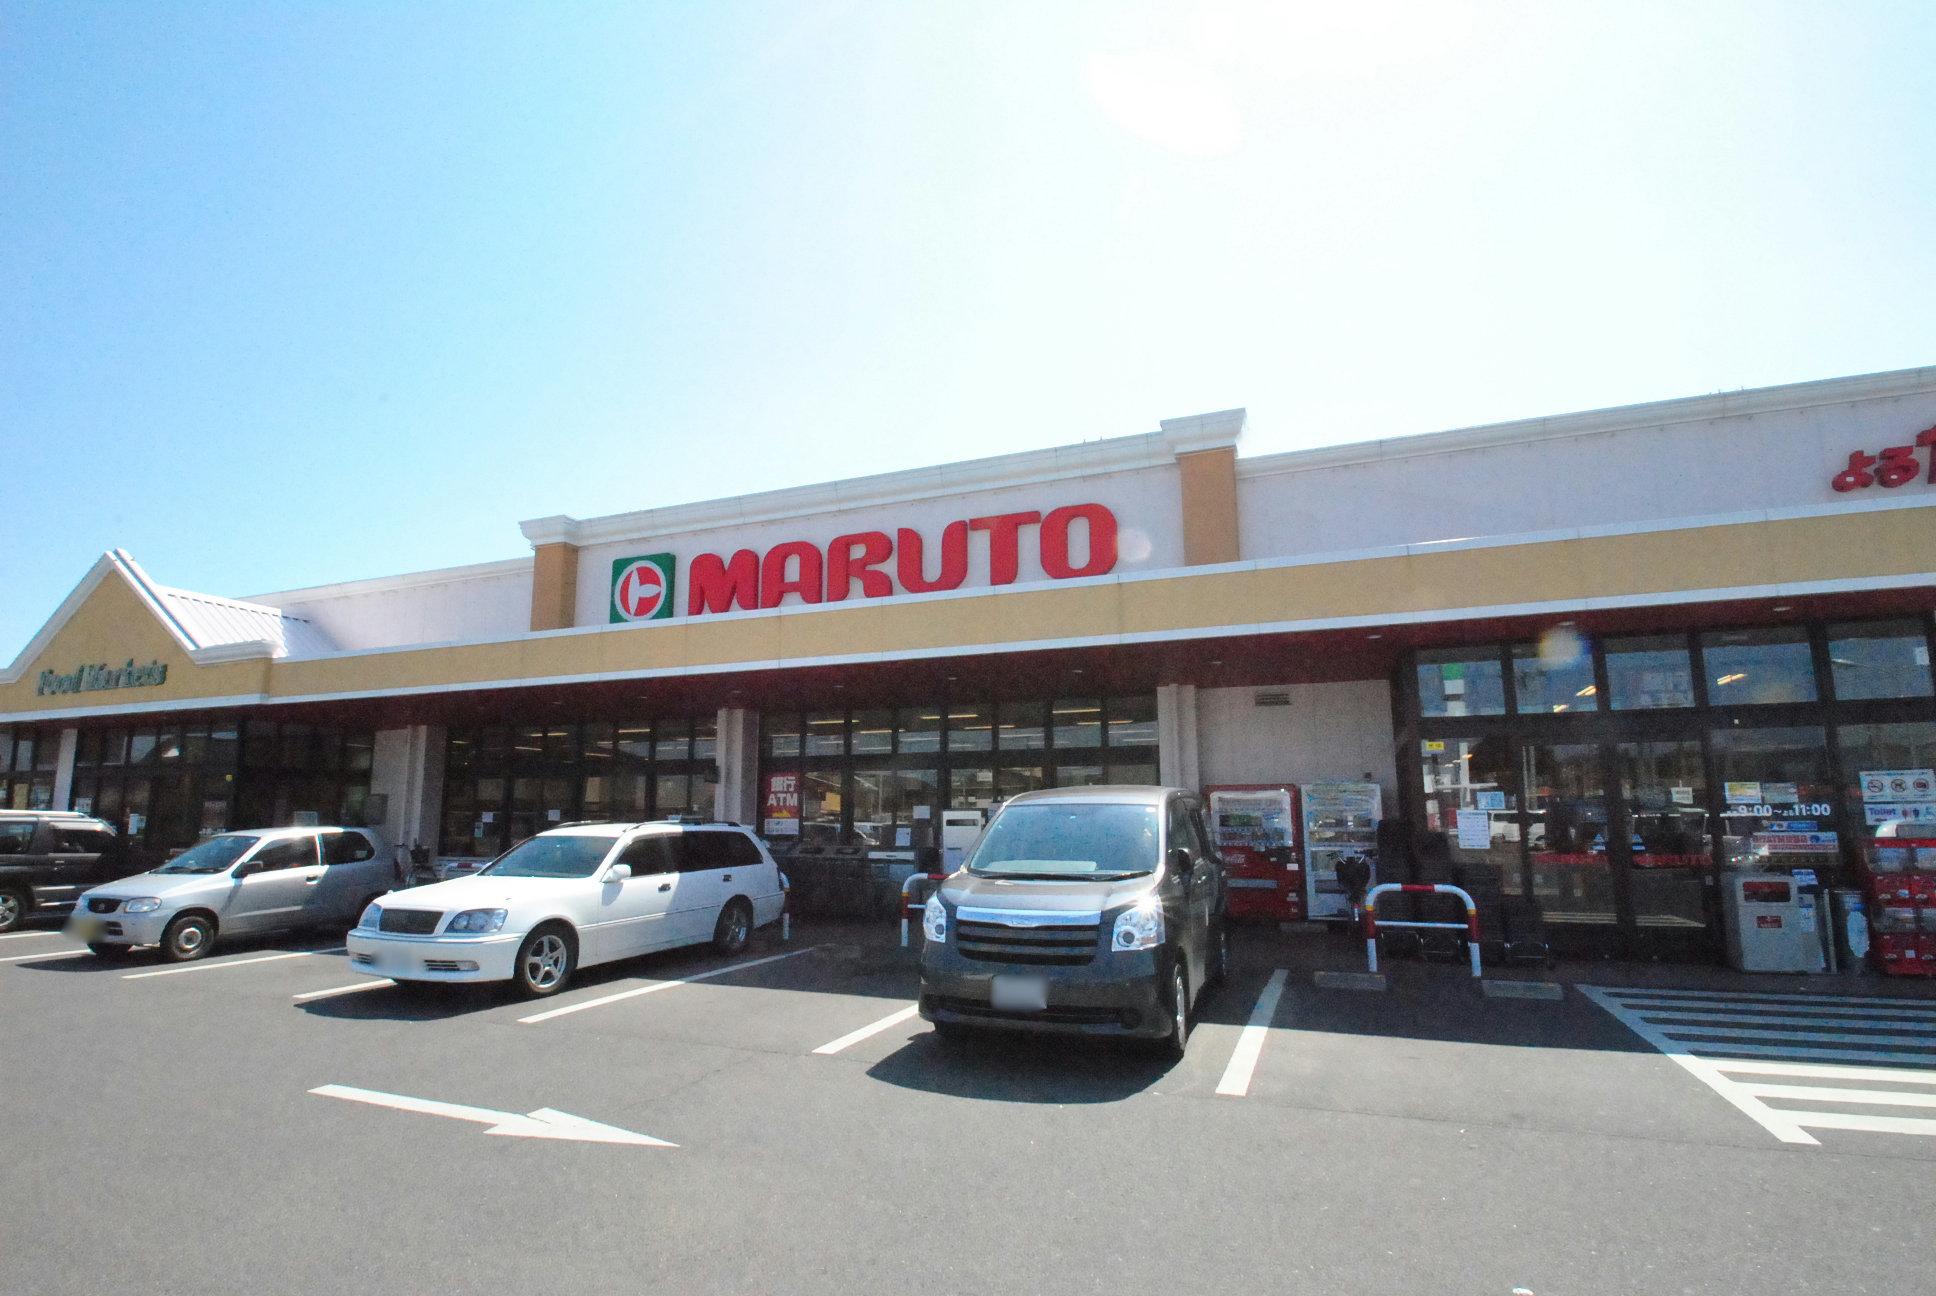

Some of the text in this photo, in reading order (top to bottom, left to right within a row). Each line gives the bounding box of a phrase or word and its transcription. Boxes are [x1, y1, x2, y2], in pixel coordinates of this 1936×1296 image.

[688, 503, 1118, 615] MARUTO
[37, 664, 86, 696] Food
[770, 776, 796, 791] 銀行
[767, 793, 798, 806] ATM
[1793, 803, 1831, 816] 11:00
